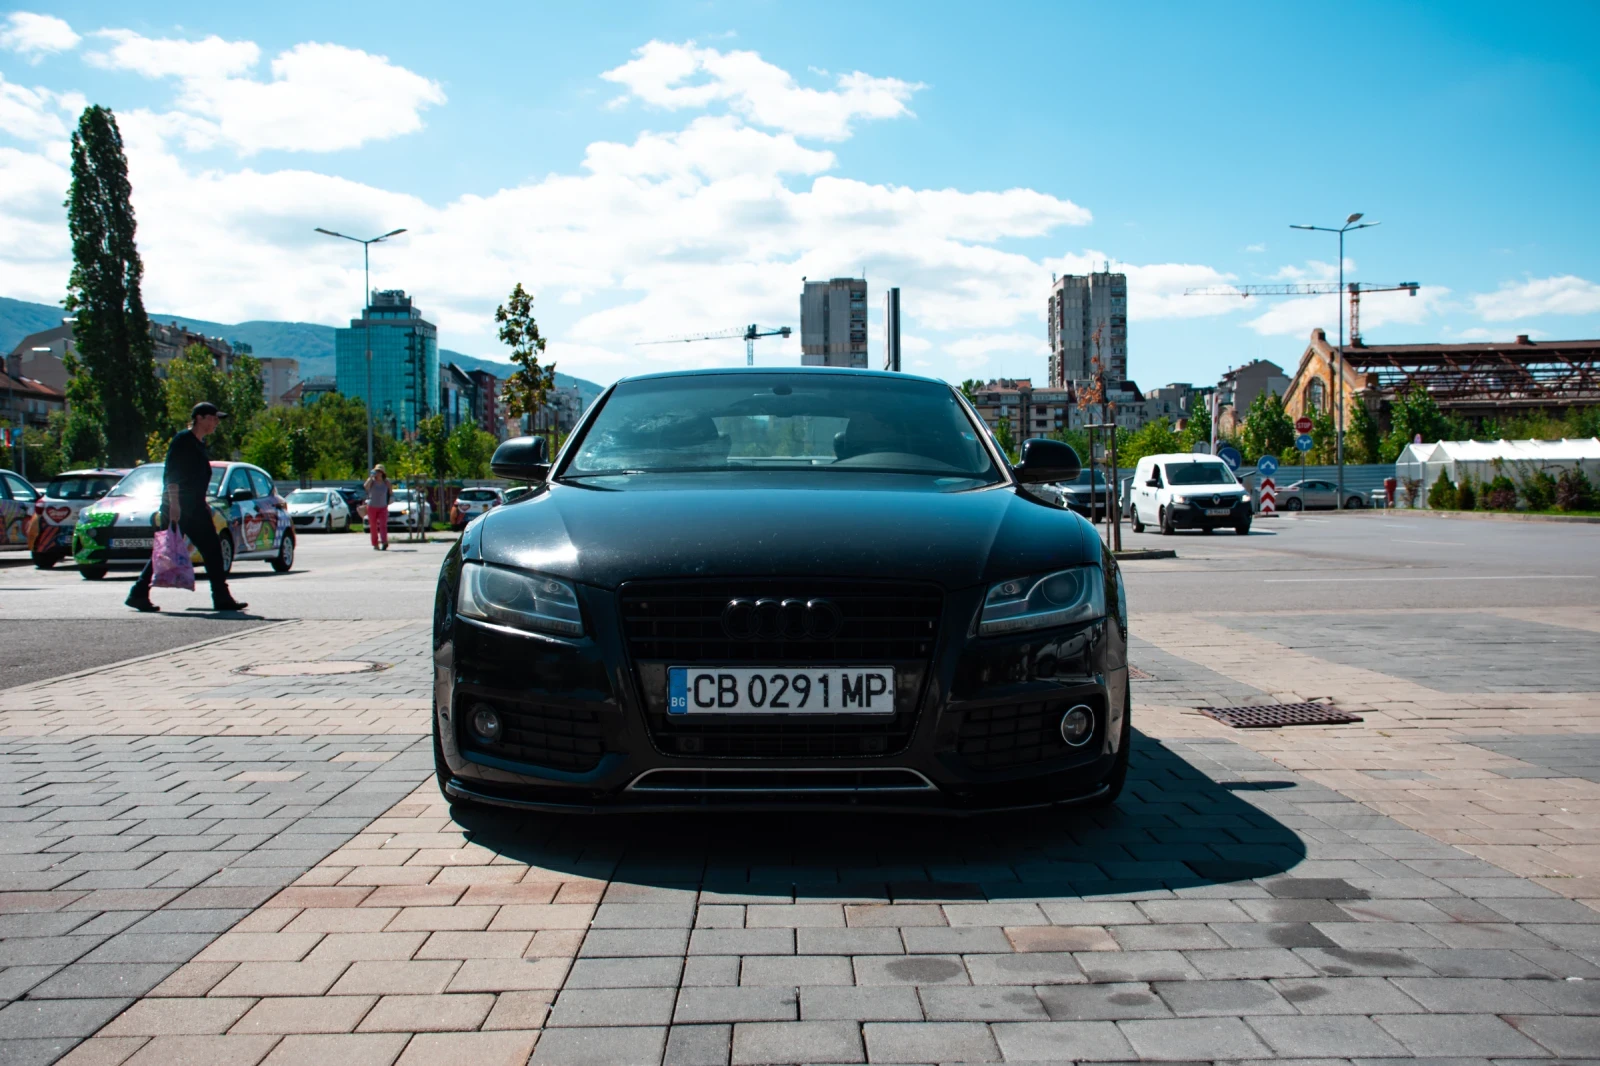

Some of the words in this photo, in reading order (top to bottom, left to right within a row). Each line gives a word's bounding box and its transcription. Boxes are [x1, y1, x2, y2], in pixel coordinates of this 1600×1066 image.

[1297, 421, 1311, 429] STOP
[693, 673, 739, 708] CB
[747, 673, 829, 708] 0291
[842, 673, 887, 708] MP
[671, 697, 686, 707] BG
